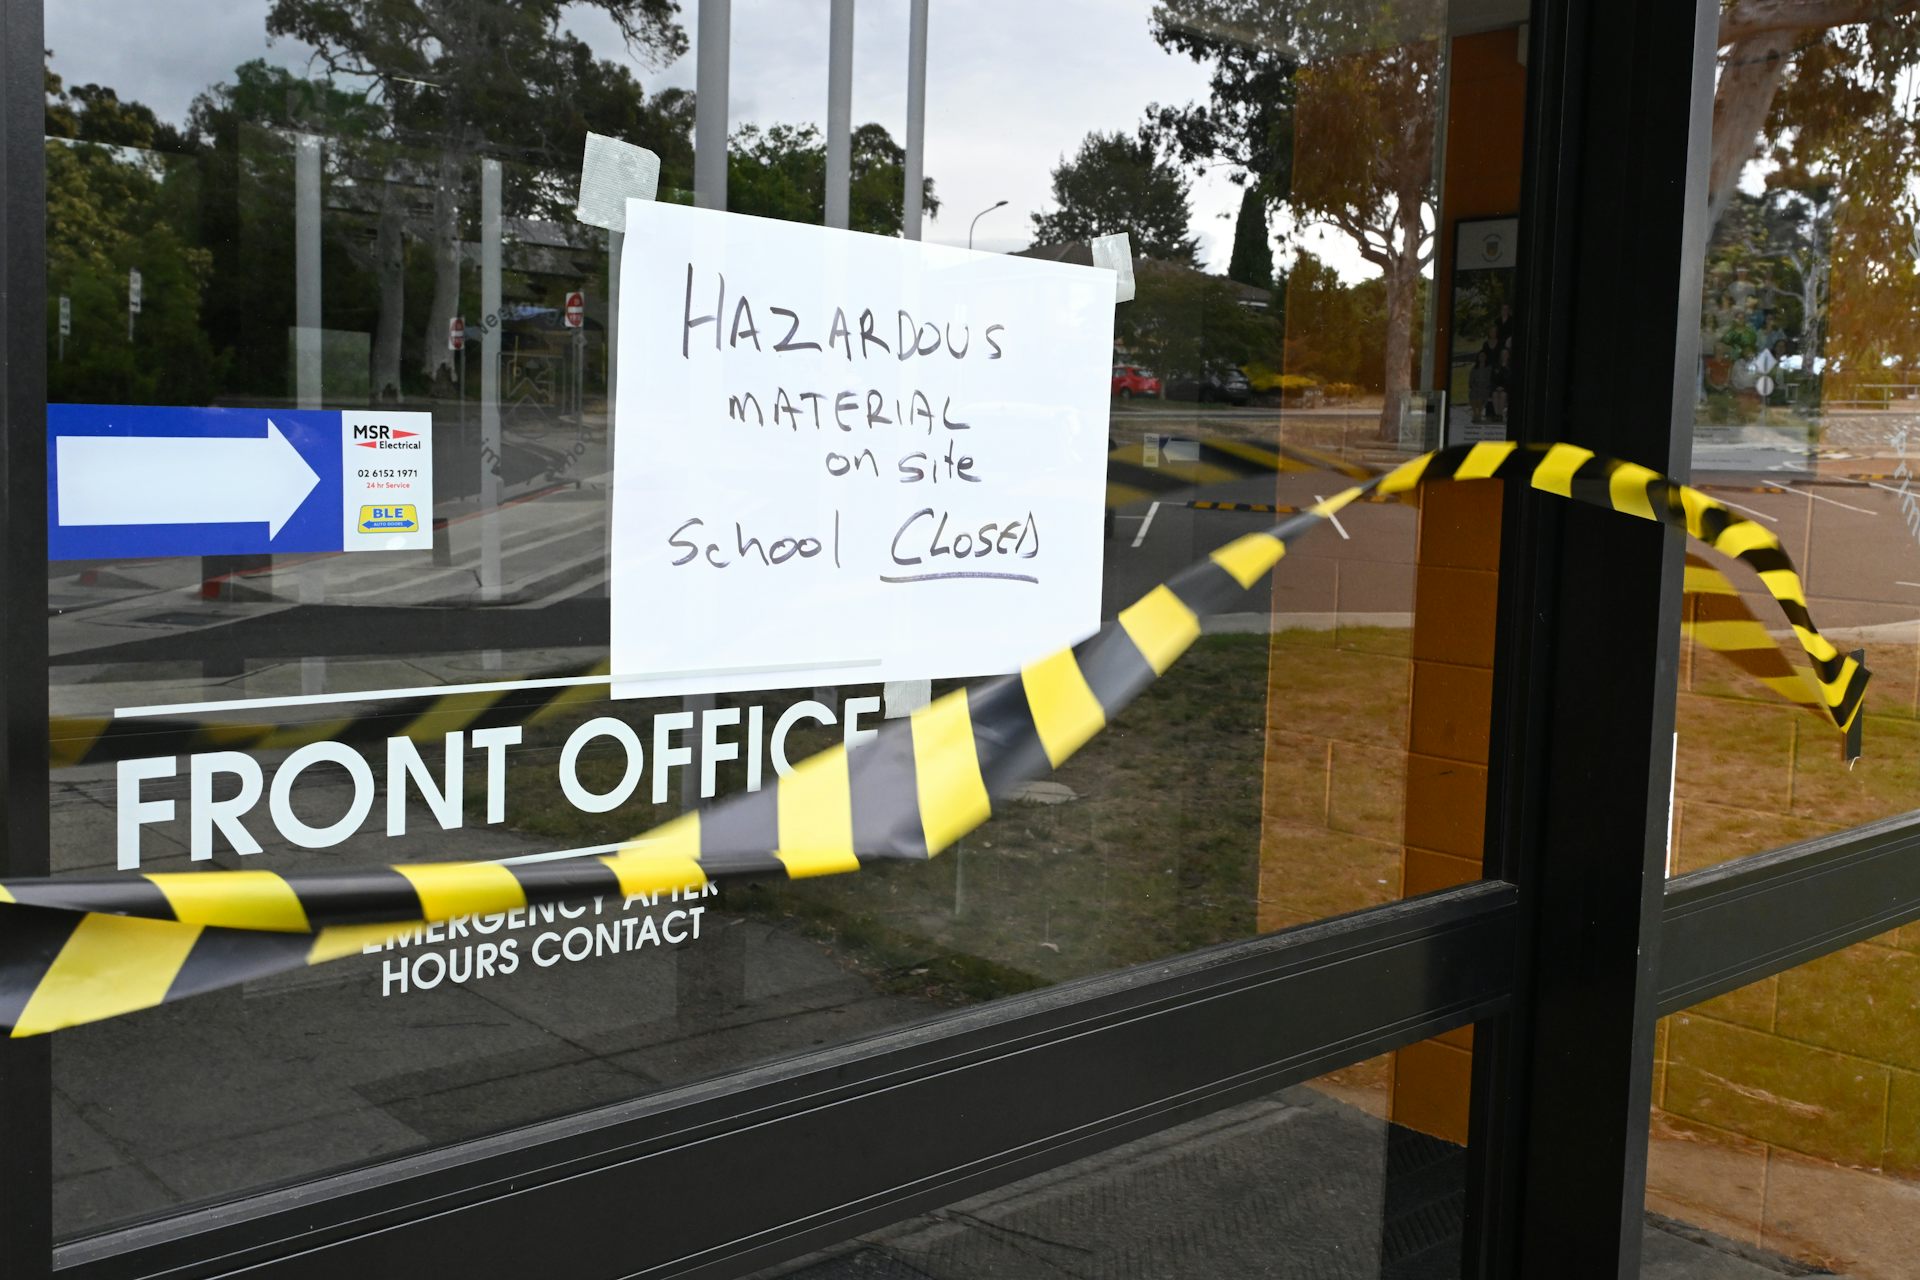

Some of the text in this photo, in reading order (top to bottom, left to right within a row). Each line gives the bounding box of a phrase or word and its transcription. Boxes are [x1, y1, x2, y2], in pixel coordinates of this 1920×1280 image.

[682, 262, 1005, 362] HAZARDOUS
[353, 425, 390, 439] MSR
[379, 440, 421, 450] Electrical
[357, 469, 418, 478] 02 6152 1971
[825, 447, 879, 478] on
[372, 508, 404, 519] BLE
[667, 507, 1040, 569] School CLOSED
[116, 725, 523, 871] FRONT
[382, 906, 705, 997] HOURS CONTACT
